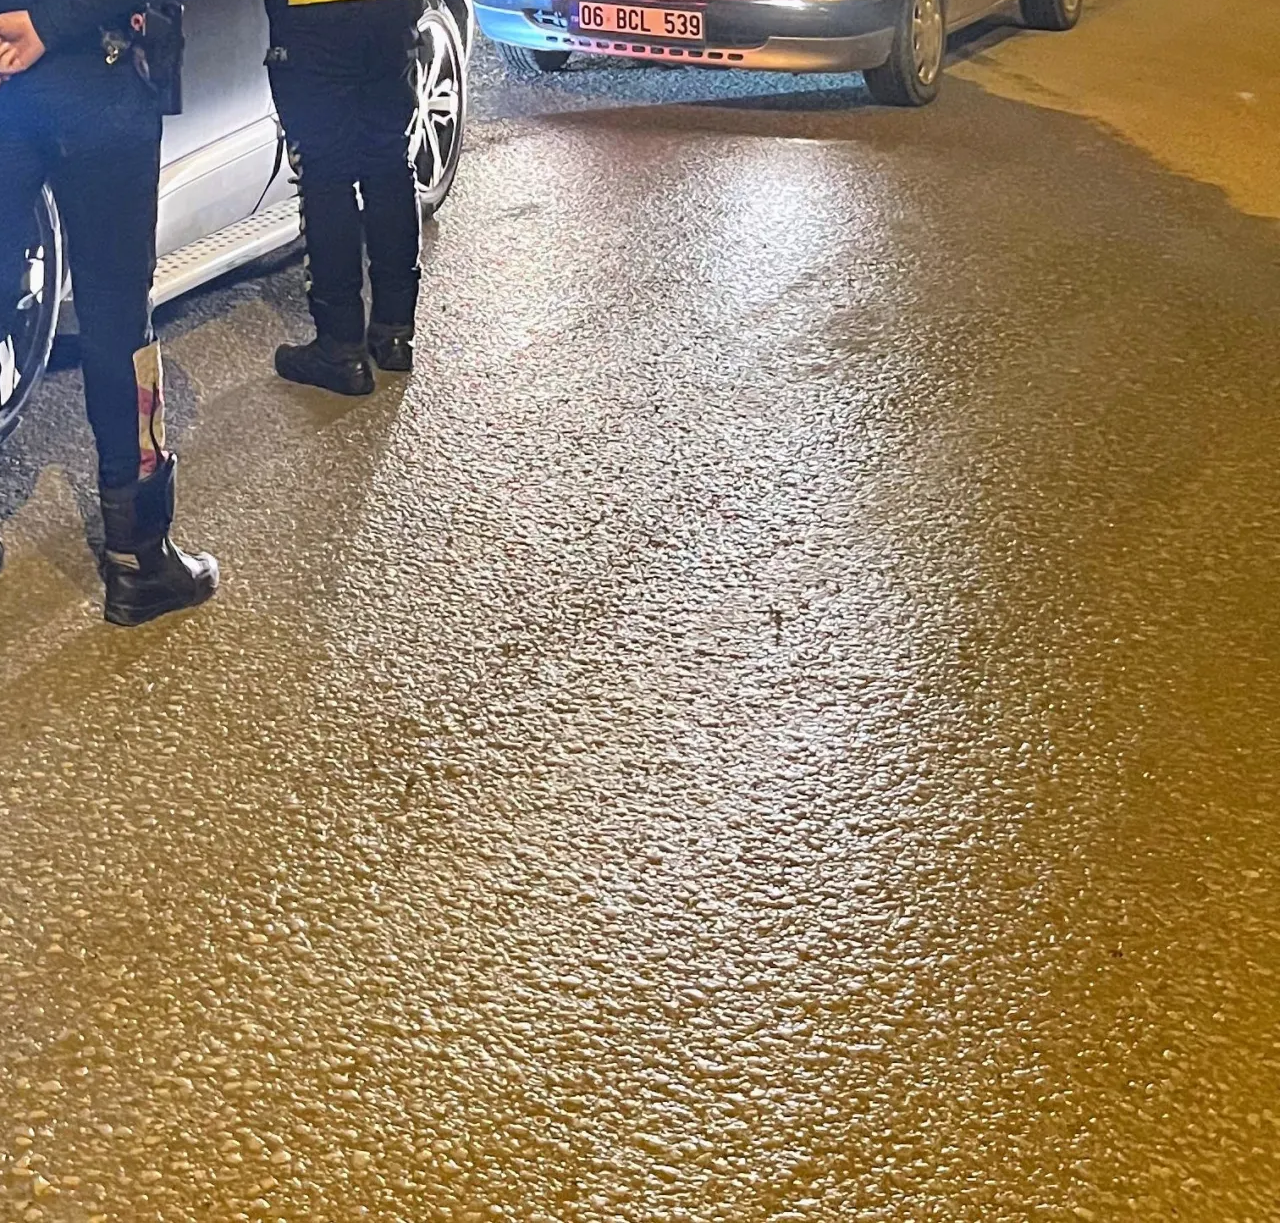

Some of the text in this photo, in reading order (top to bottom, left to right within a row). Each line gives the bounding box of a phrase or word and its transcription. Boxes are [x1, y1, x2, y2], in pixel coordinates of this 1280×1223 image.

[581, 5, 700, 36] 06 BCL 539
